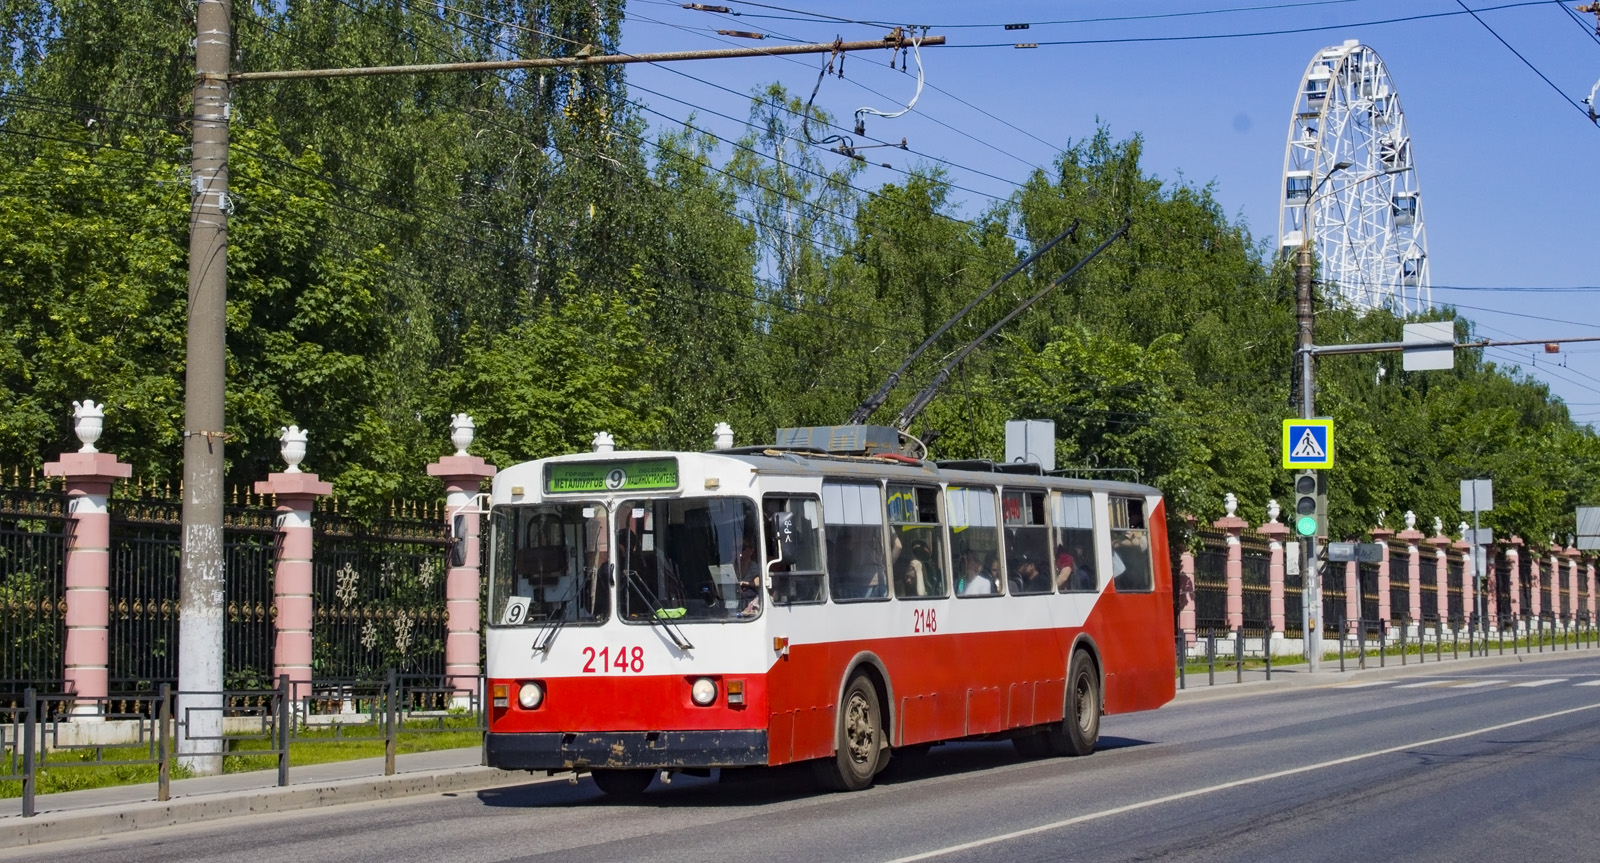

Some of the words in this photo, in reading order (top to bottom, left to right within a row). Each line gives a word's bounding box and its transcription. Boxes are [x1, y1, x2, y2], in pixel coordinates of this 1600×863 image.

[554, 477, 603, 489] МЕТАЛЛУРГОВ
[610, 470, 623, 489] 9
[626, 472, 677, 486] МАШИНОСТРОИТЕЛЕ
[508, 604, 521, 623] 9
[914, 608, 937, 633] 2148
[582, 646, 645, 674] 2148
